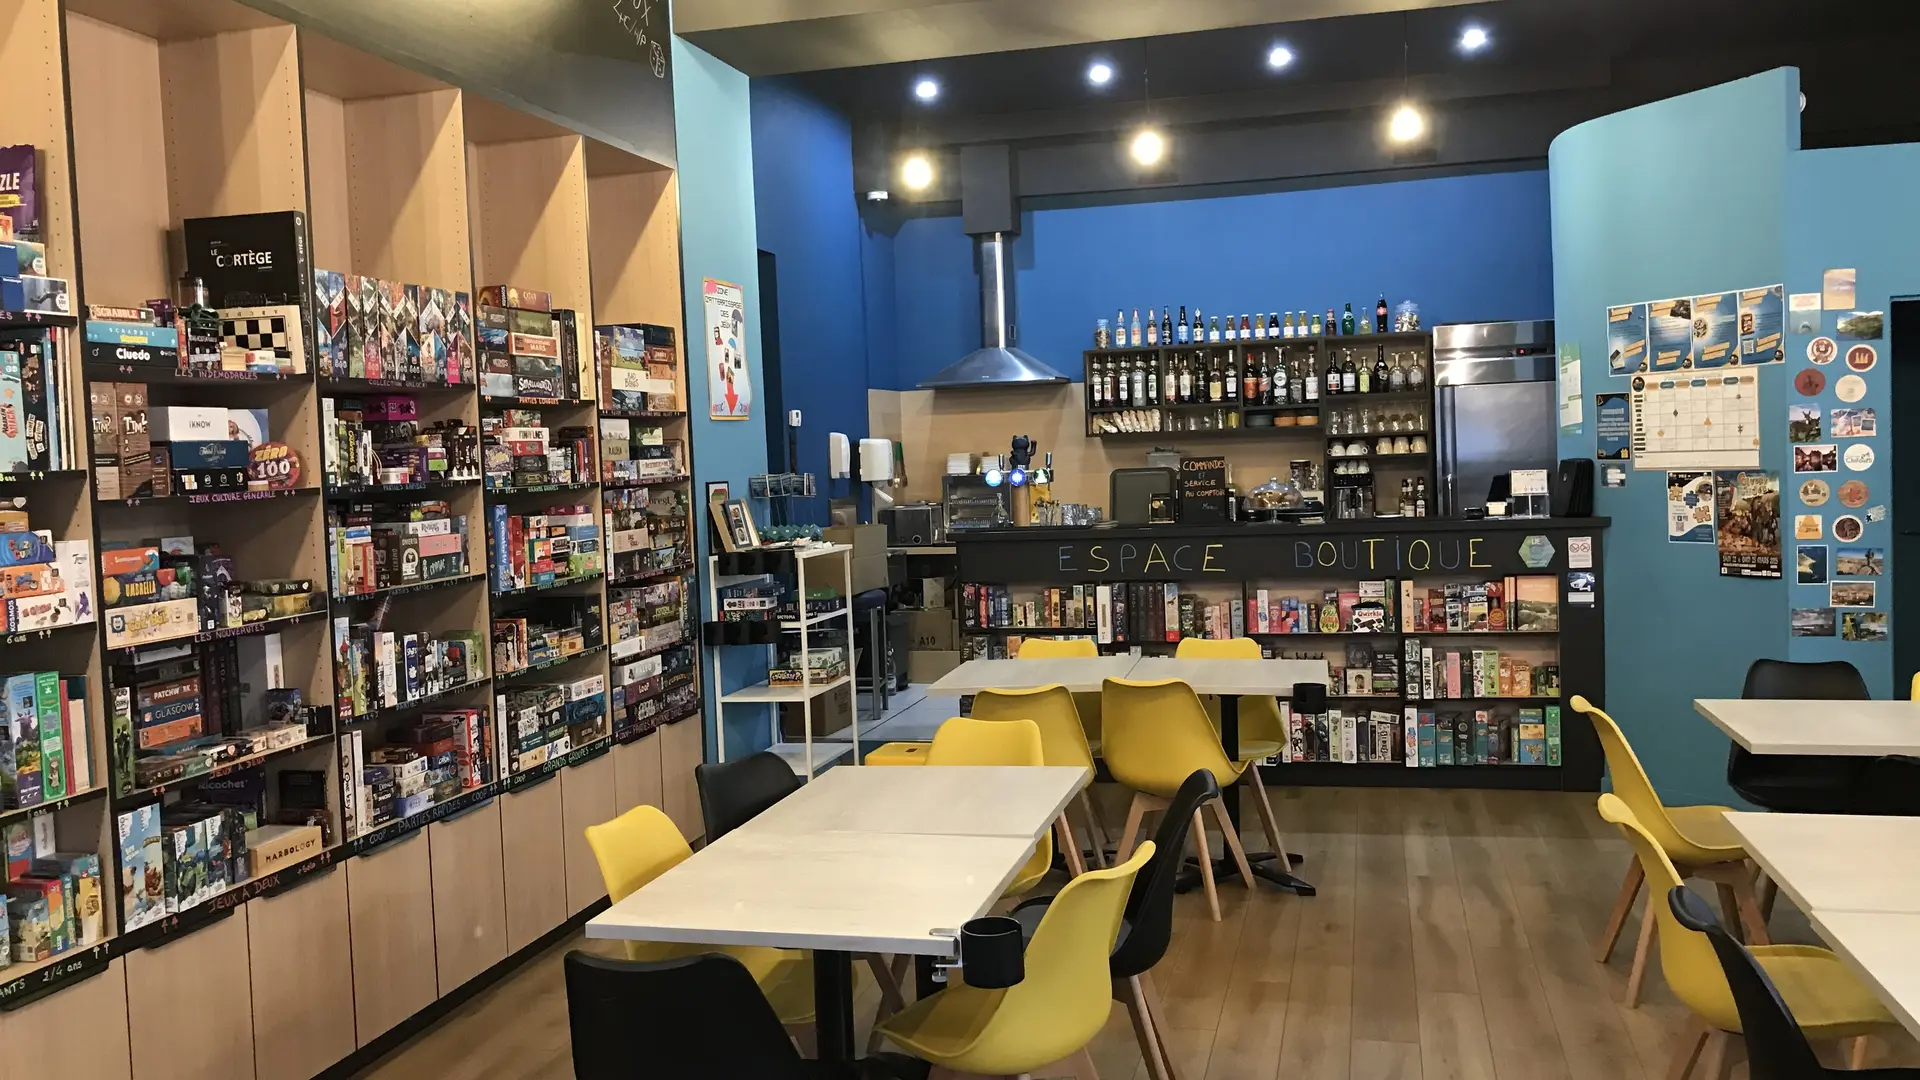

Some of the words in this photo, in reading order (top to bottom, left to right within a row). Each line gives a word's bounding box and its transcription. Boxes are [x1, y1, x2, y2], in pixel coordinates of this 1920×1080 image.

[96, 307, 139, 319] SCRABBLE
[116, 347, 151, 361] Cluedo
[175, 369, 194, 378] LES
[1058, 542, 1227, 574] ESPACE
[1294, 535, 1493, 572] BOUTIQUE
[919, 636, 936, 646] A10
[155, 702, 194, 719] GLASGOW
[542, 758, 567, 773] GRANDS
[398, 812, 430, 833] PARTIES
[266, 838, 316, 863] MARBOLOGY
[208, 893, 239, 914] JEUX
[254, 874, 281, 894] DEUX
